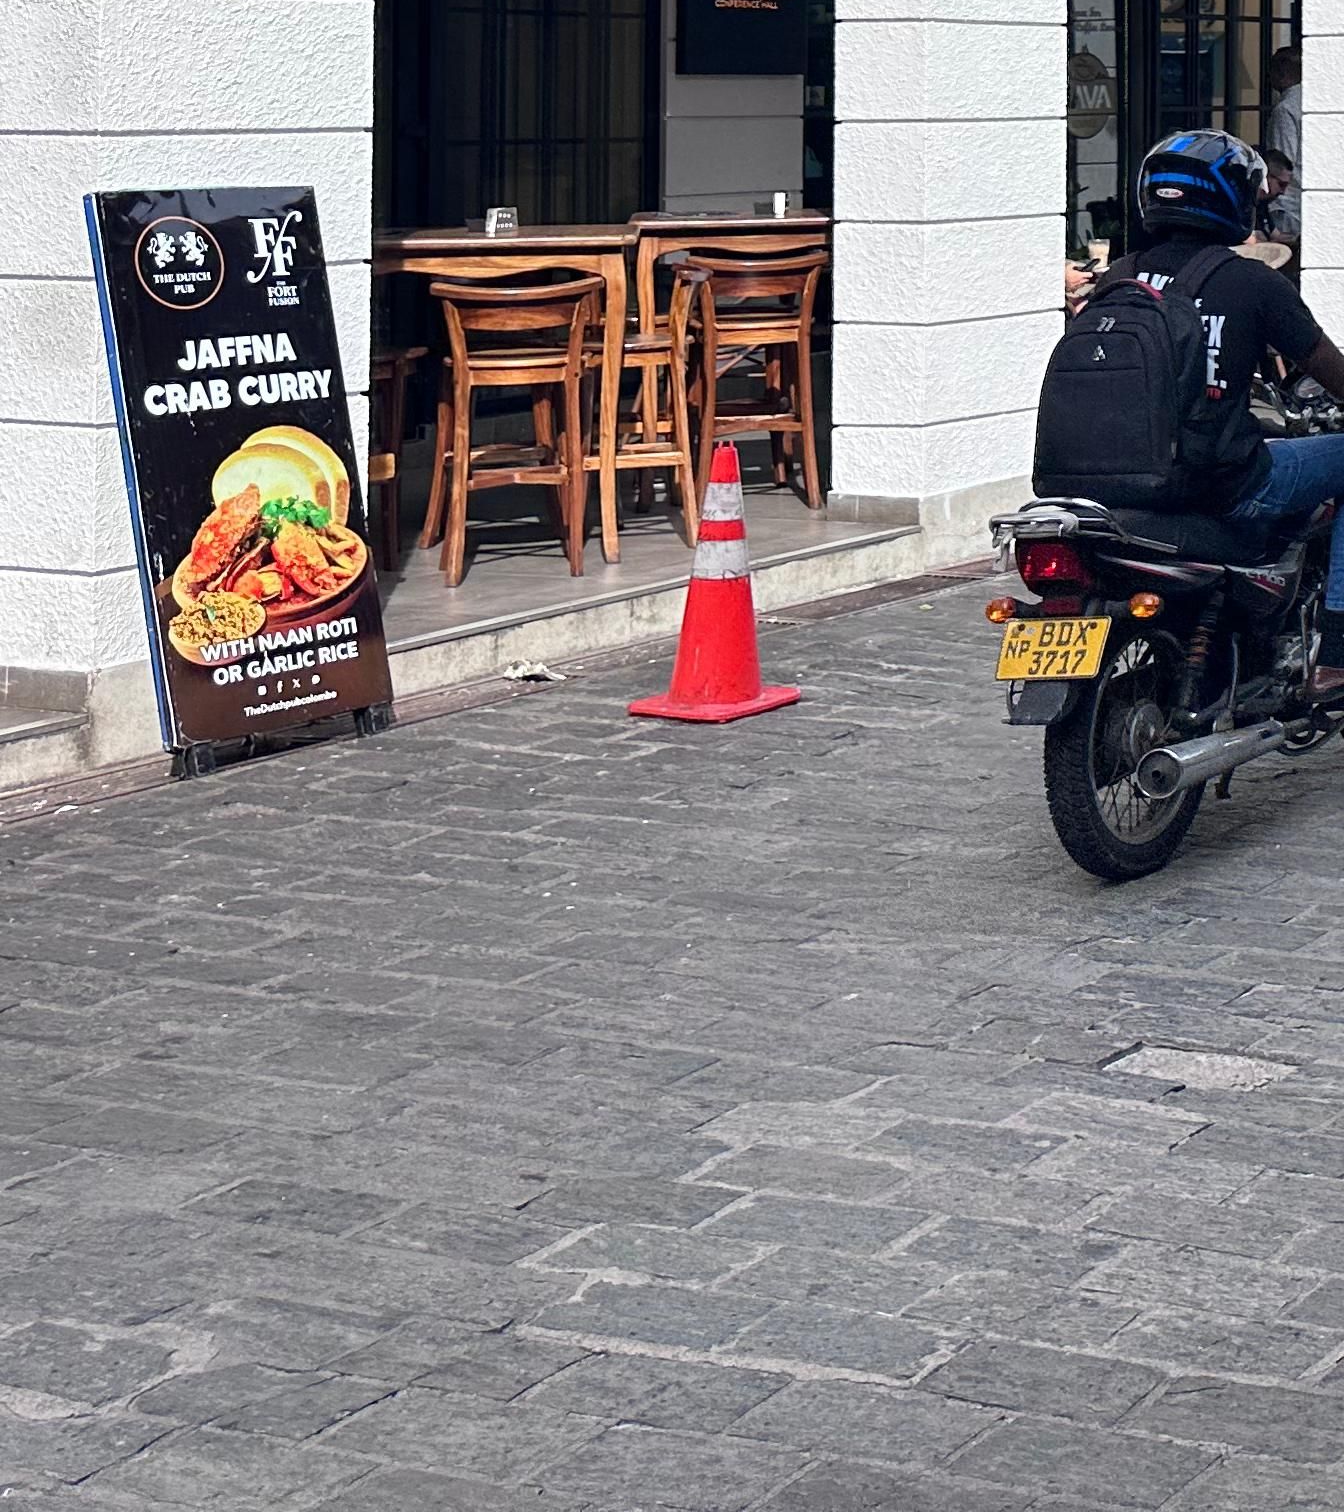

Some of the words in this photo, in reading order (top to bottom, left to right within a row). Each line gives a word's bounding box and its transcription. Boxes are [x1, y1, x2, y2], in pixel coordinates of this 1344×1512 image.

[153, 272, 175, 284] THE
[176, 271, 211, 282] DUTCH
[174, 283, 196, 295] PUB
[267, 285, 297, 297] FORT
[268, 296, 300, 306] FUSION
[177, 332, 297, 371] JAFFNA
[143, 378, 232, 416] CRAB
[238, 369, 332, 406] CURRY
[200, 637, 256, 662] WITH
[258, 625, 314, 652] NAAN
[316, 616, 358, 641] ROTI
[1039, 621, 1091, 647] BDX
[213, 664, 244, 685] OR
[247, 649, 316, 679] GARLIC
[318, 640, 359, 665] RICE
[1006, 640, 1031, 659] NP
[1028, 649, 1088, 675] 3717
